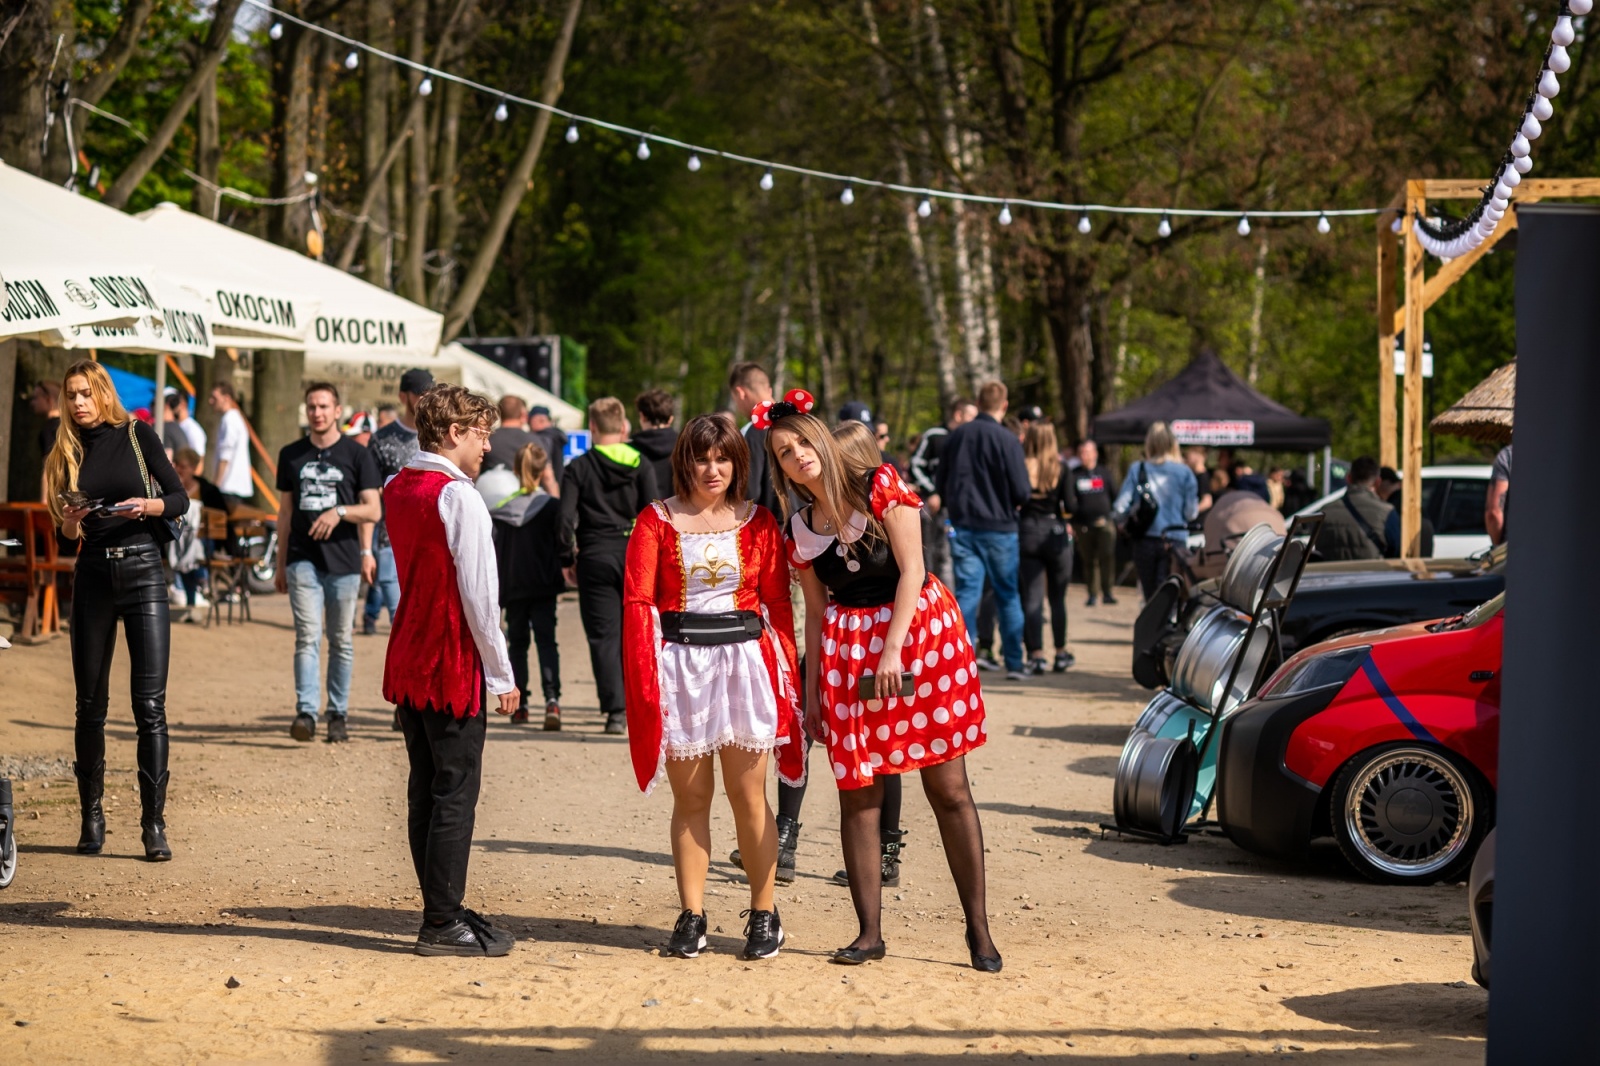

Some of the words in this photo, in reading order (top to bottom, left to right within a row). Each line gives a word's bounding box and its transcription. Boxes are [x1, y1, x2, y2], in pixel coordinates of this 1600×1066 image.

[90, 275, 159, 311] OKOCIM
[217, 290, 296, 329] OKOCIM
[163, 308, 208, 347] OKOCIM
[316, 316, 407, 346] OKOCIM
